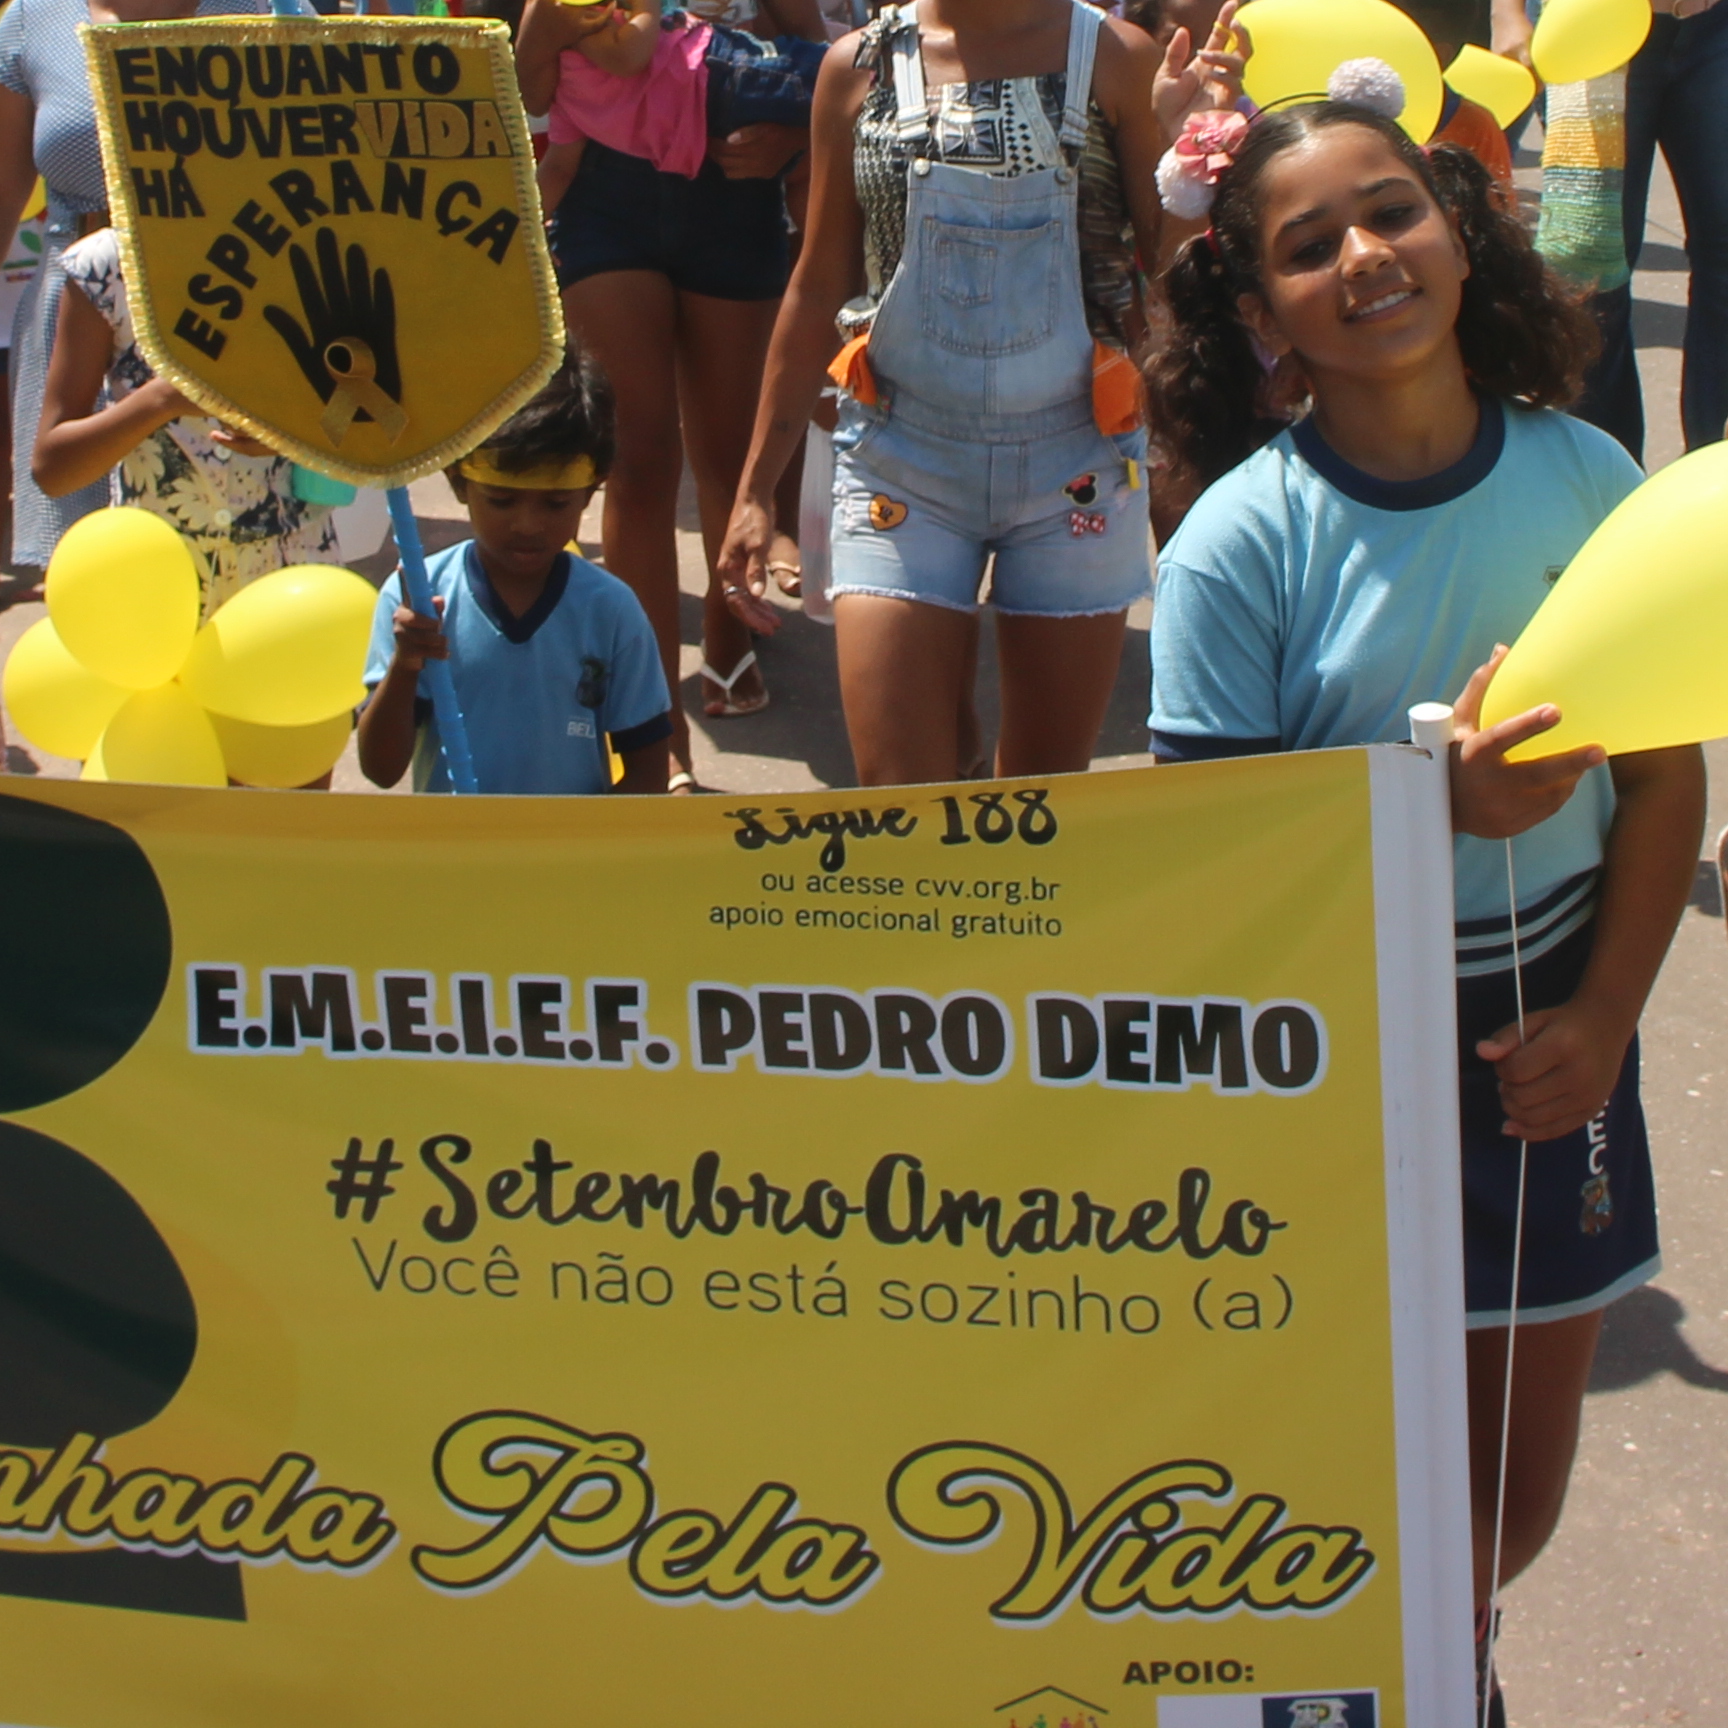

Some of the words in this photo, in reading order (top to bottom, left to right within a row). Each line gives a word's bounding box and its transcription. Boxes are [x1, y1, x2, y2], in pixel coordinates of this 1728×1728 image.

[114, 43, 461, 112] ENQUANTO
[124, 100, 360, 159] HOUVER
[130, 156, 206, 218] HÁ
[173, 159, 520, 362] ESPERANÇA
[567, 720, 595, 739] BEL
[930, 788, 1058, 846] 188
[762, 872, 795, 892] ou
[806, 874, 904, 897] acesse
[916, 876, 1062, 906] cvv.org.br
[709, 901, 784, 932] apoio
[795, 906, 940, 933] emocional
[950, 908, 1063, 939] gratuito
[192, 967, 674, 1065] E.M.E.I.E.F.
[696, 986, 1010, 1076] PEDRO
[1034, 995, 1322, 1090] DEMO
[352, 1236, 522, 1297] Você
[549, 1254, 675, 1307] não
[703, 1260, 850, 1309] está
[877, 1270, 1163, 1335] sozinho
[1190, 1274, 1295, 1332] (a)
[408, 1406, 880, 1608] Pela
[882, 1436, 1378, 1624] Vida
[1123, 1659, 1255, 1685] APOIO:
